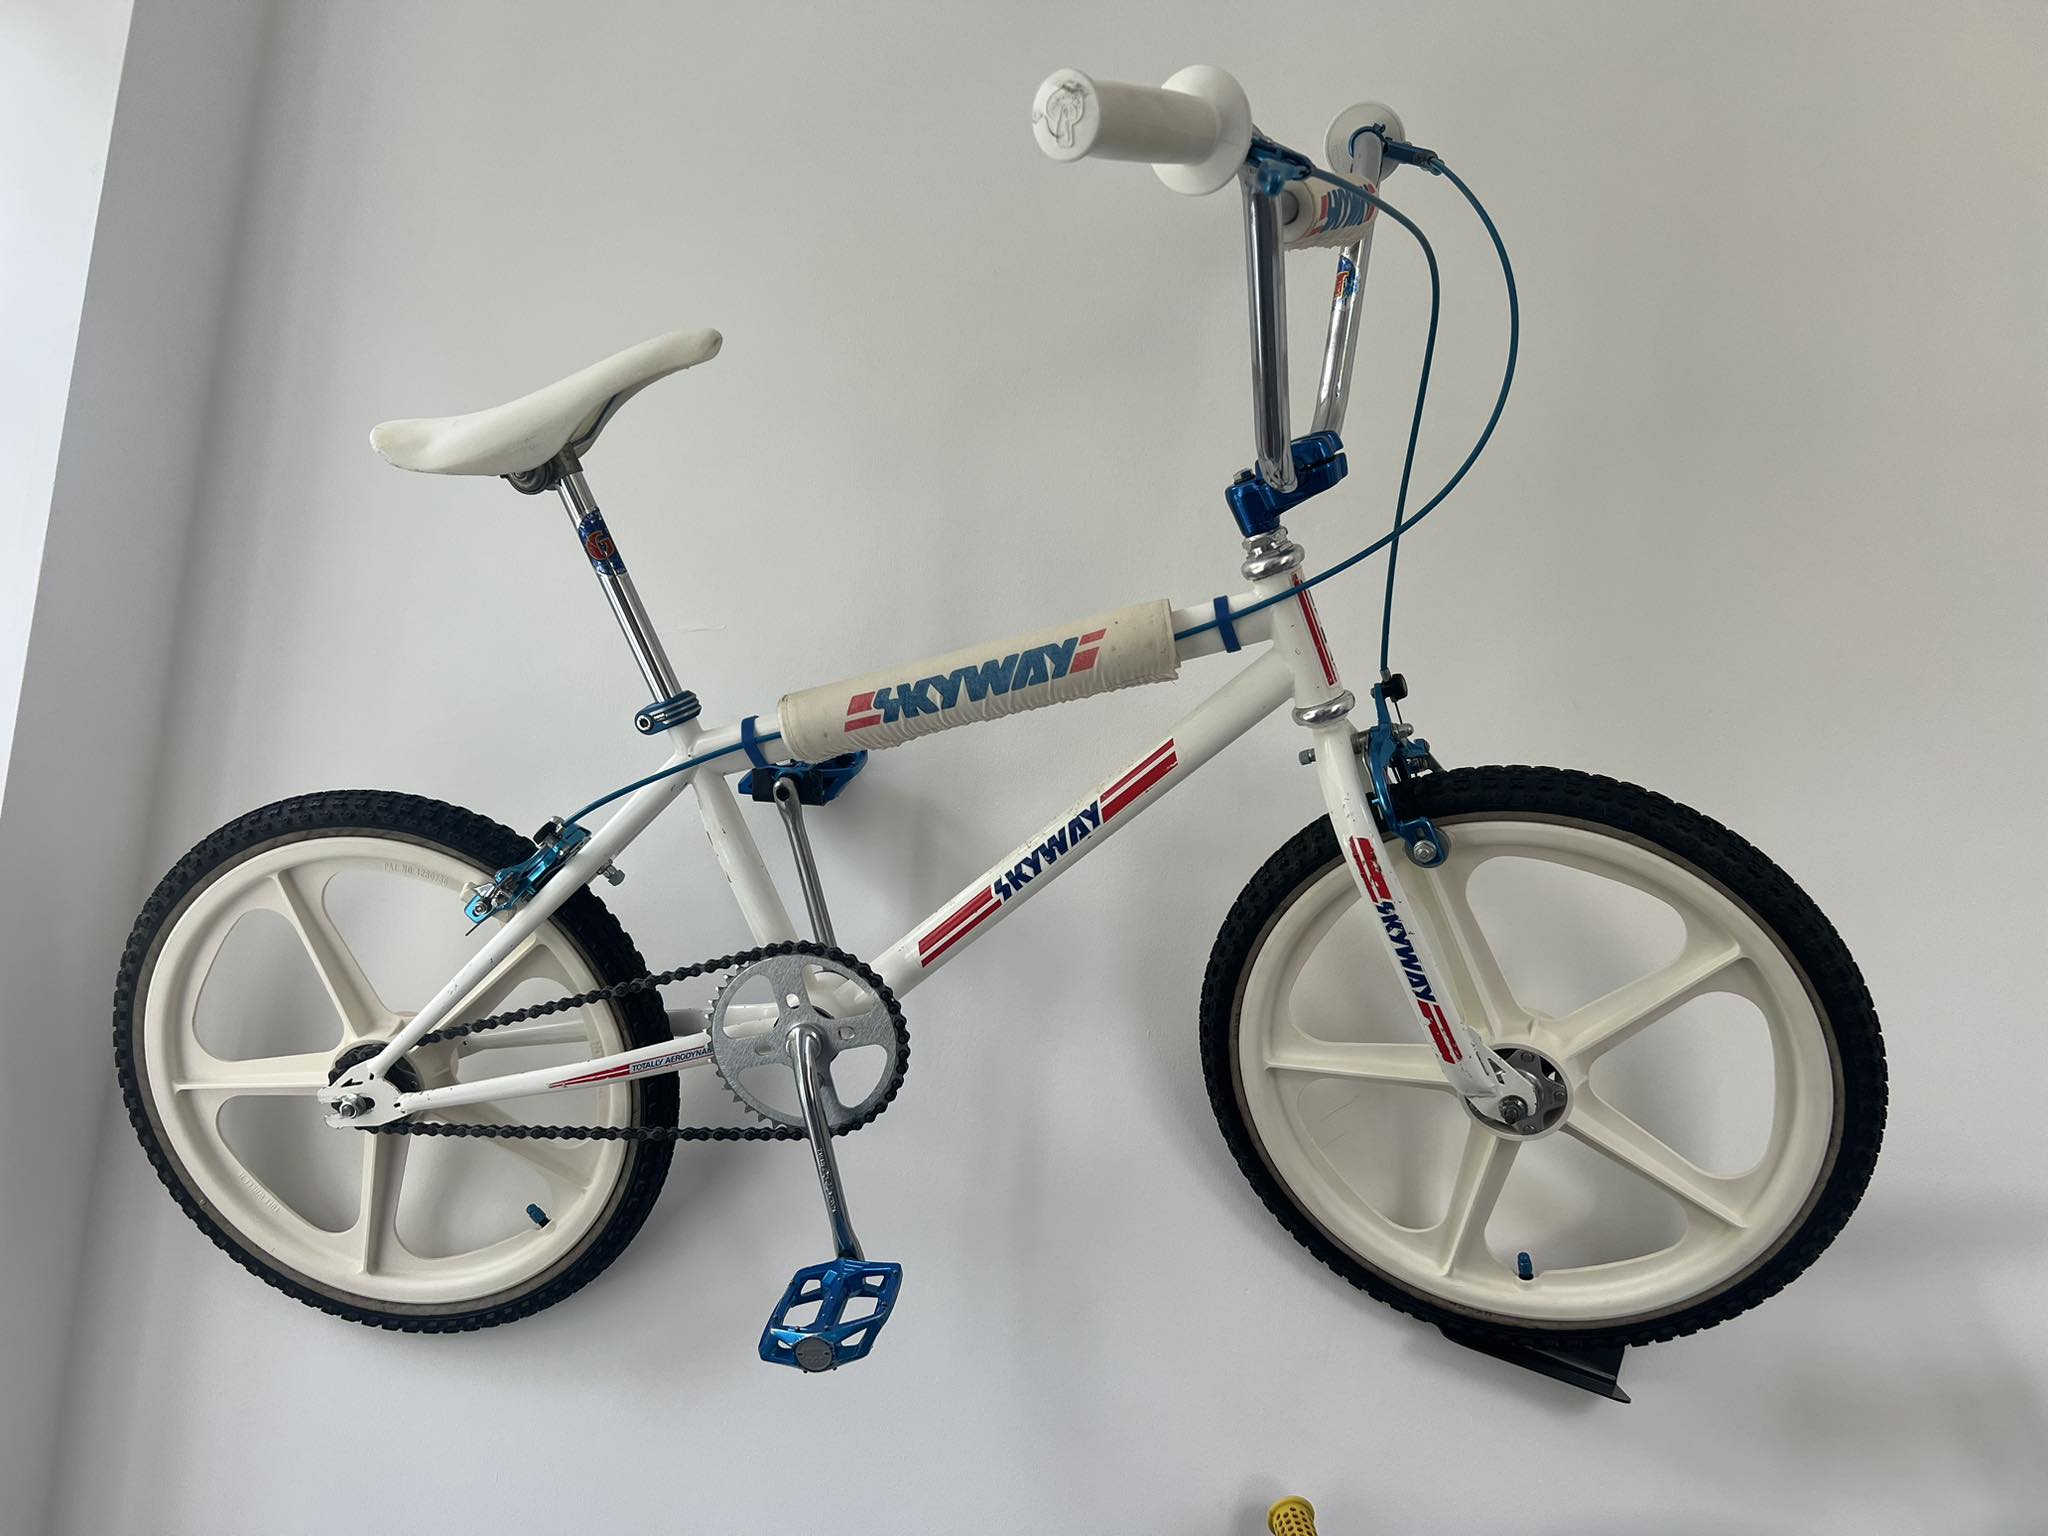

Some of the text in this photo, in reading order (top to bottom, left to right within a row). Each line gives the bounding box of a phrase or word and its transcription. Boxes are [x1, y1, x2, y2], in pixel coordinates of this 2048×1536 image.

[873, 636, 1080, 724] SKYWAY
[993, 799, 1101, 901] SKYWAY
[1375, 901, 1437, 1003] SKYWAY
[631, 1058, 665, 1072] TOTALLY
